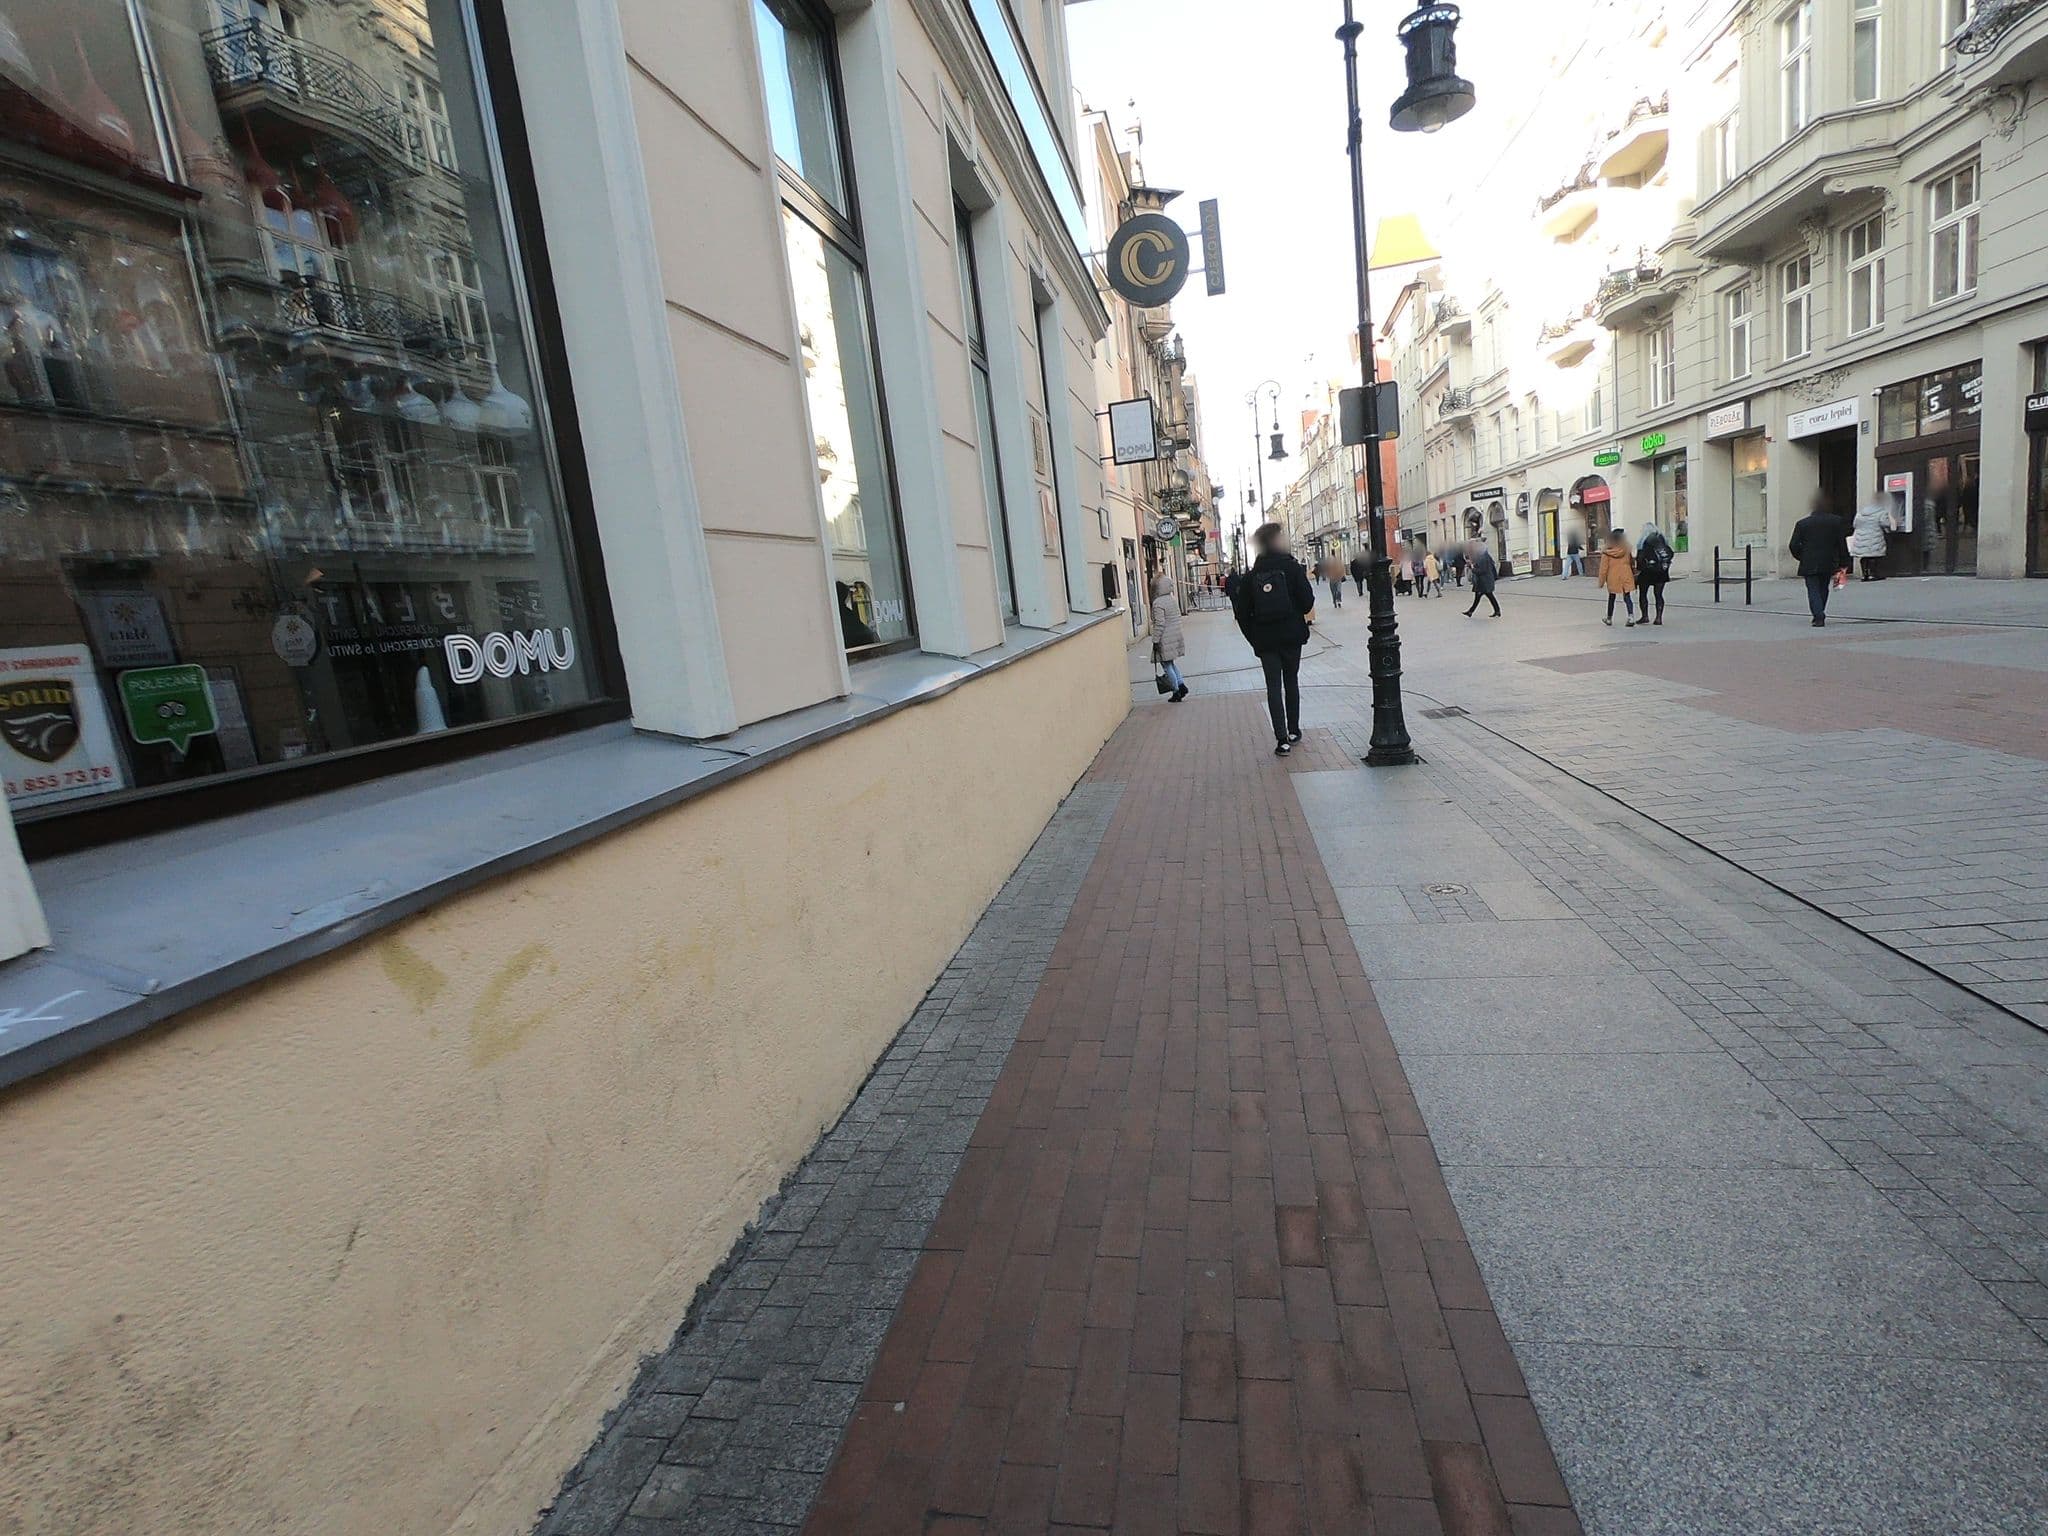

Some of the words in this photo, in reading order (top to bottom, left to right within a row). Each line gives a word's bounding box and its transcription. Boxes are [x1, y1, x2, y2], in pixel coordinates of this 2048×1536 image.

[1117, 442, 1152, 458] DOMU
[872, 599, 904, 624] DOMU
[444, 626, 575, 685] DOMU
[0, 687, 71, 711] SOLID
